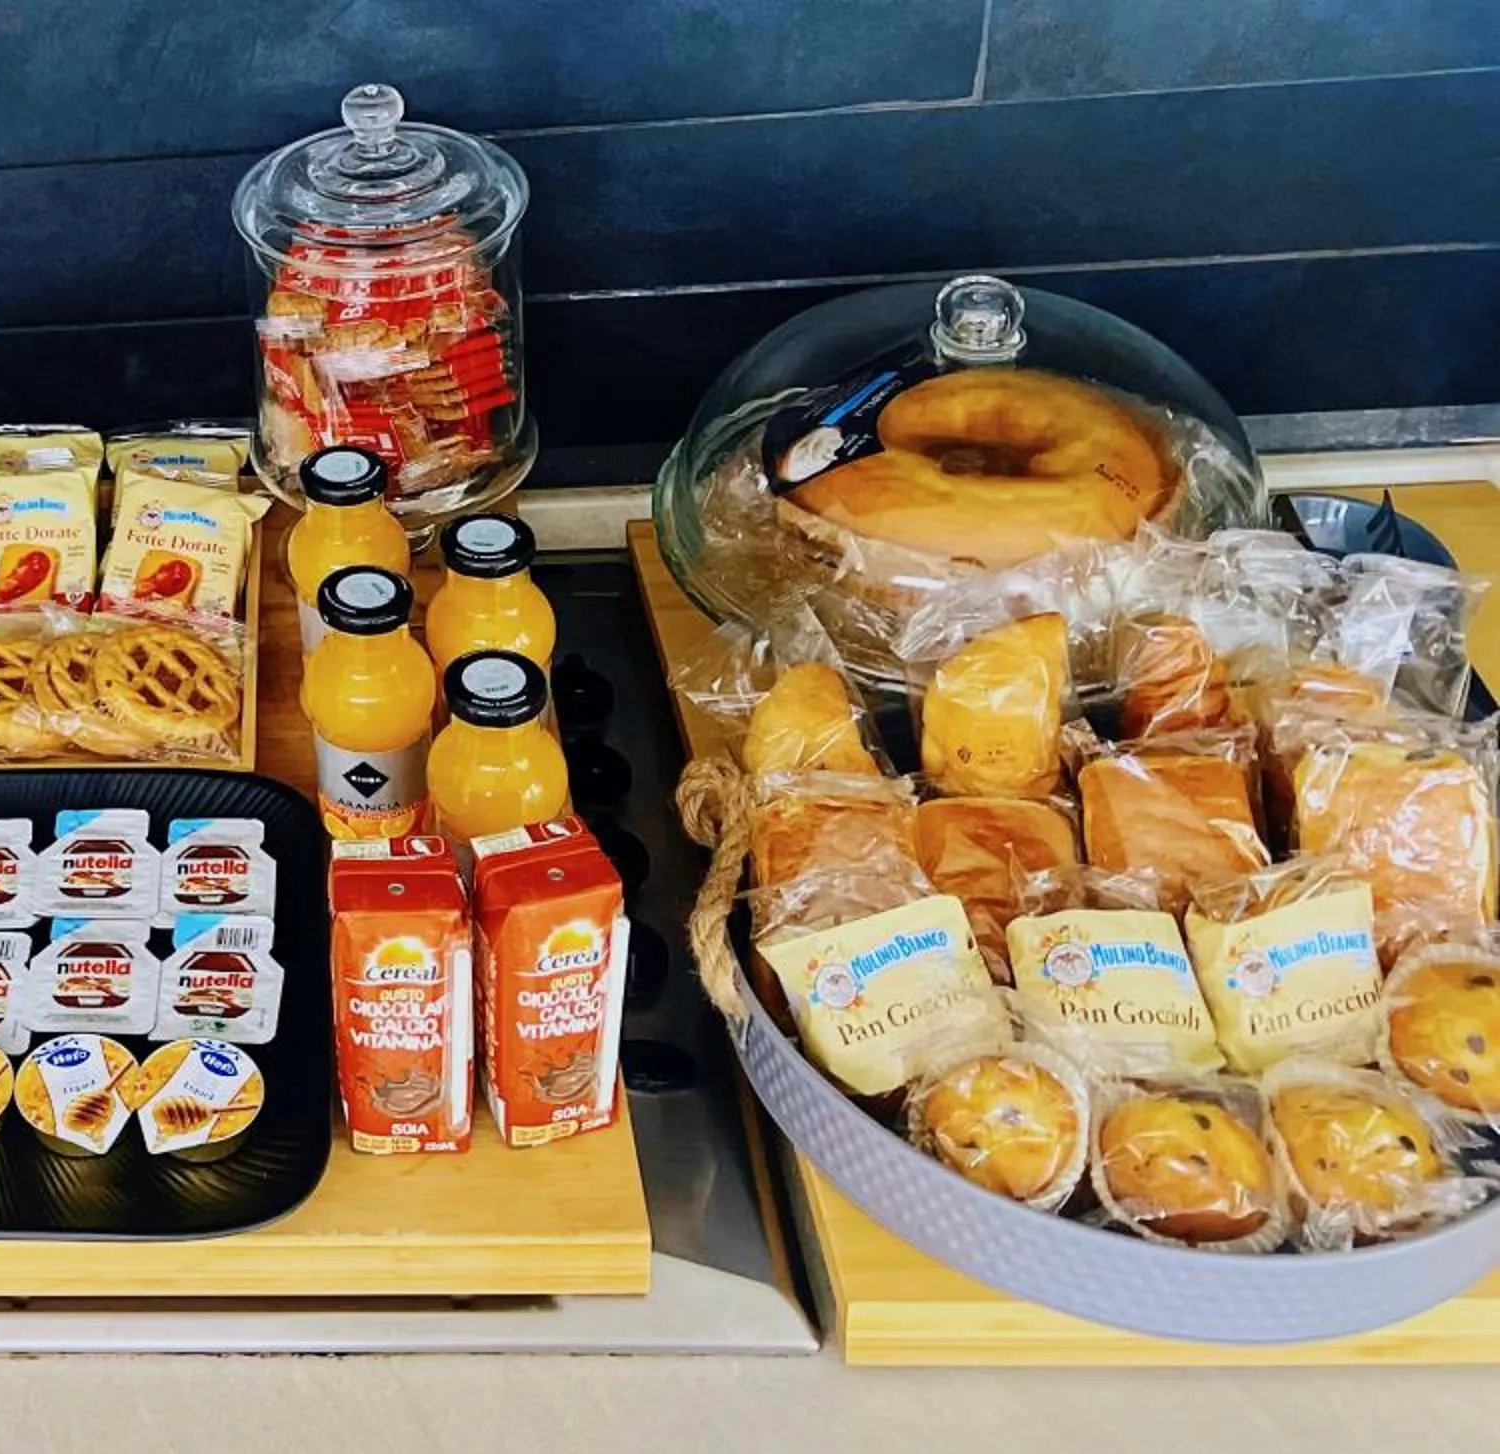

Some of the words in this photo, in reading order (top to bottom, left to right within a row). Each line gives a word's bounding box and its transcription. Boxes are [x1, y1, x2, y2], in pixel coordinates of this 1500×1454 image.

[25, 525, 82, 541] Dorate
[126, 528, 166, 547] Fette
[170, 535, 228, 555] Dorate
[338, 798, 402, 811] ARANCIA
[62, 855, 134, 870] nutella
[177, 860, 249, 875] nutella
[851, 944, 901, 980] MULINO
[900, 929, 948, 959] BIANCO
[1090, 942, 1145, 968] MULINO
[1144, 942, 1187, 974] BIANCO
[1267, 943, 1318, 970] MULINO
[1317, 931, 1369, 956] BIANCO
[57, 960, 131, 976] nutella
[179, 972, 254, 989] nutella
[550, 971, 594, 991] GUSTO
[380, 987, 425, 1001] GUSTO
[540, 999, 601, 1023] CALCIO
[1060, 1000, 1108, 1024] Pan
[1113, 999, 1201, 1031] Goccioli
[371, 1018, 438, 1036] CALCIO
[837, 1017, 886, 1047] Pan
[1250, 1011, 1291, 1035] Pan
[349, 1027, 443, 1051] VITAMINA
[51, 1050, 88, 1066] Hero
[204, 1052, 237, 1076] Hero
[551, 1103, 589, 1121] SOIA
[391, 1122, 431, 1136] SOIA
